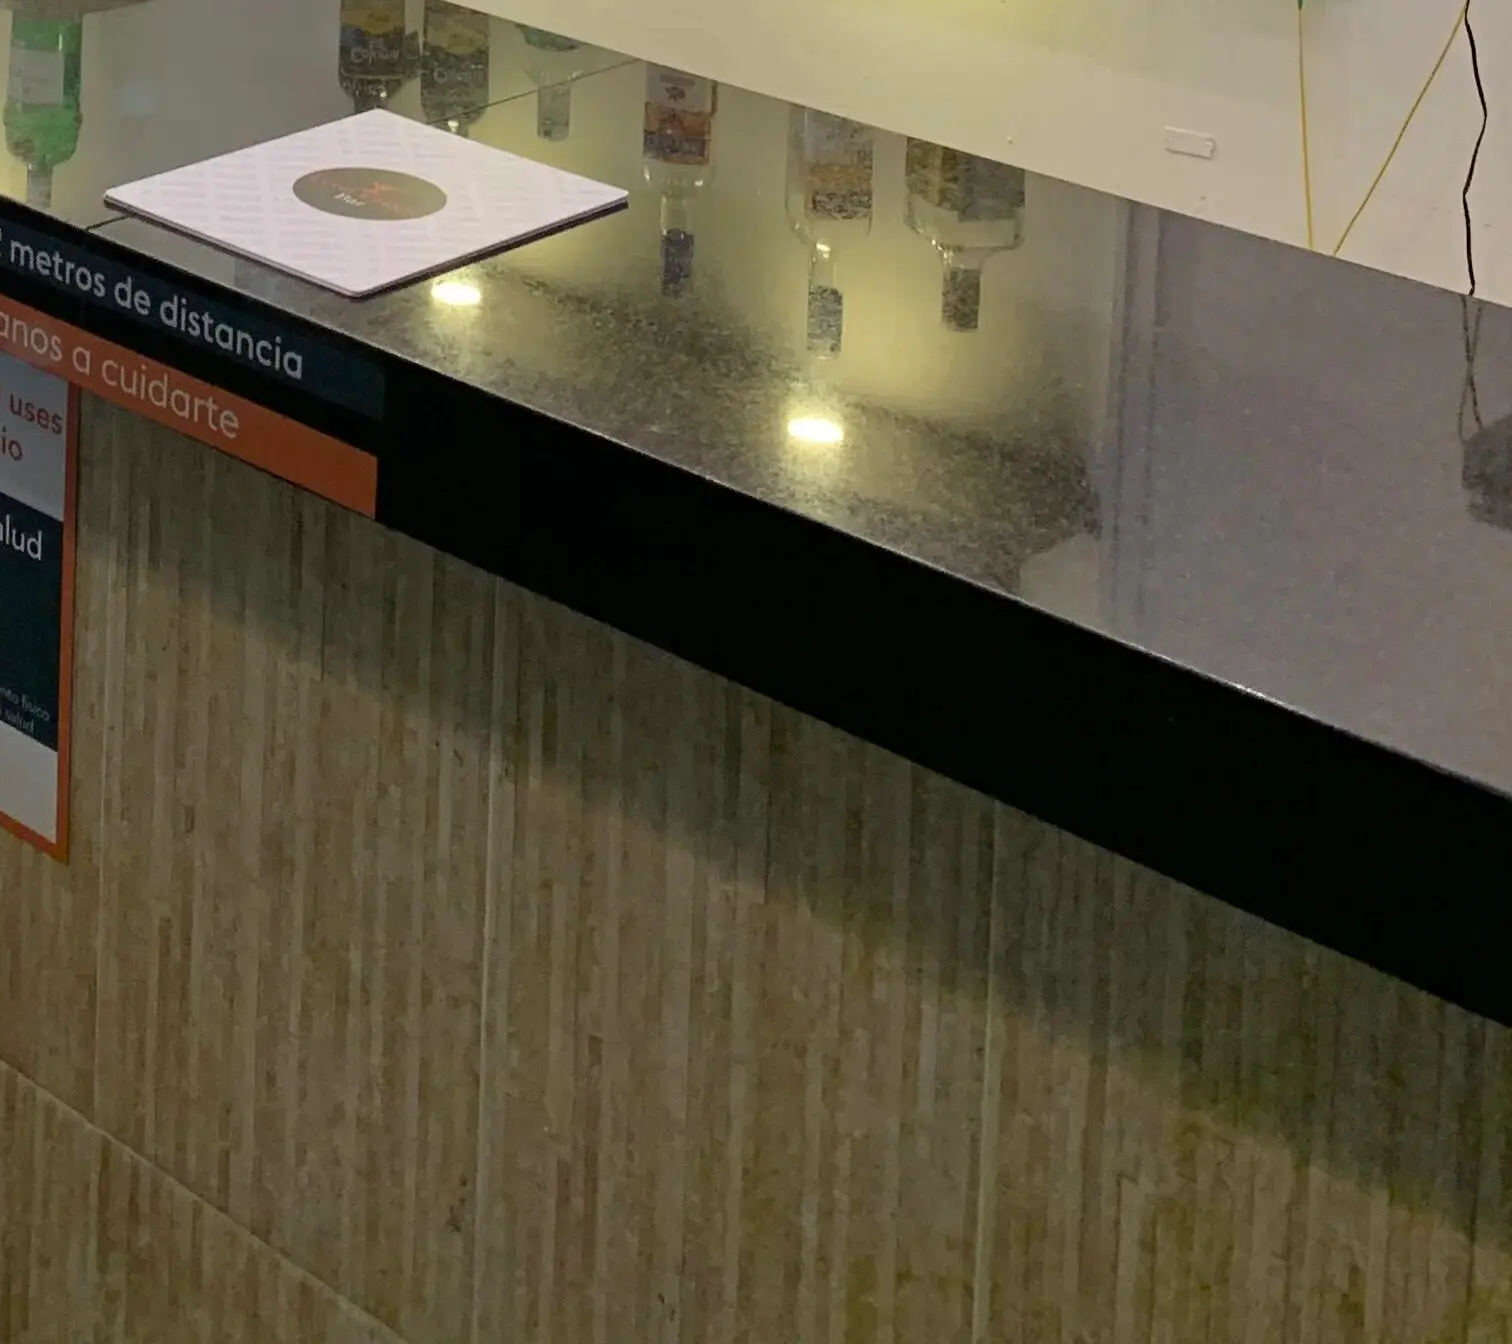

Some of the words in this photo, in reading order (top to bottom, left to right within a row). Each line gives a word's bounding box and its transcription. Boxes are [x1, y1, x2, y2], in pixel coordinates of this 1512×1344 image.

[9, 240, 108, 300] metros
[113, 275, 151, 317] de
[159, 296, 304, 382] distancia
[8, 391, 64, 437] uses
[72, 346, 92, 376] a
[101, 357, 241, 440] cuidarte
